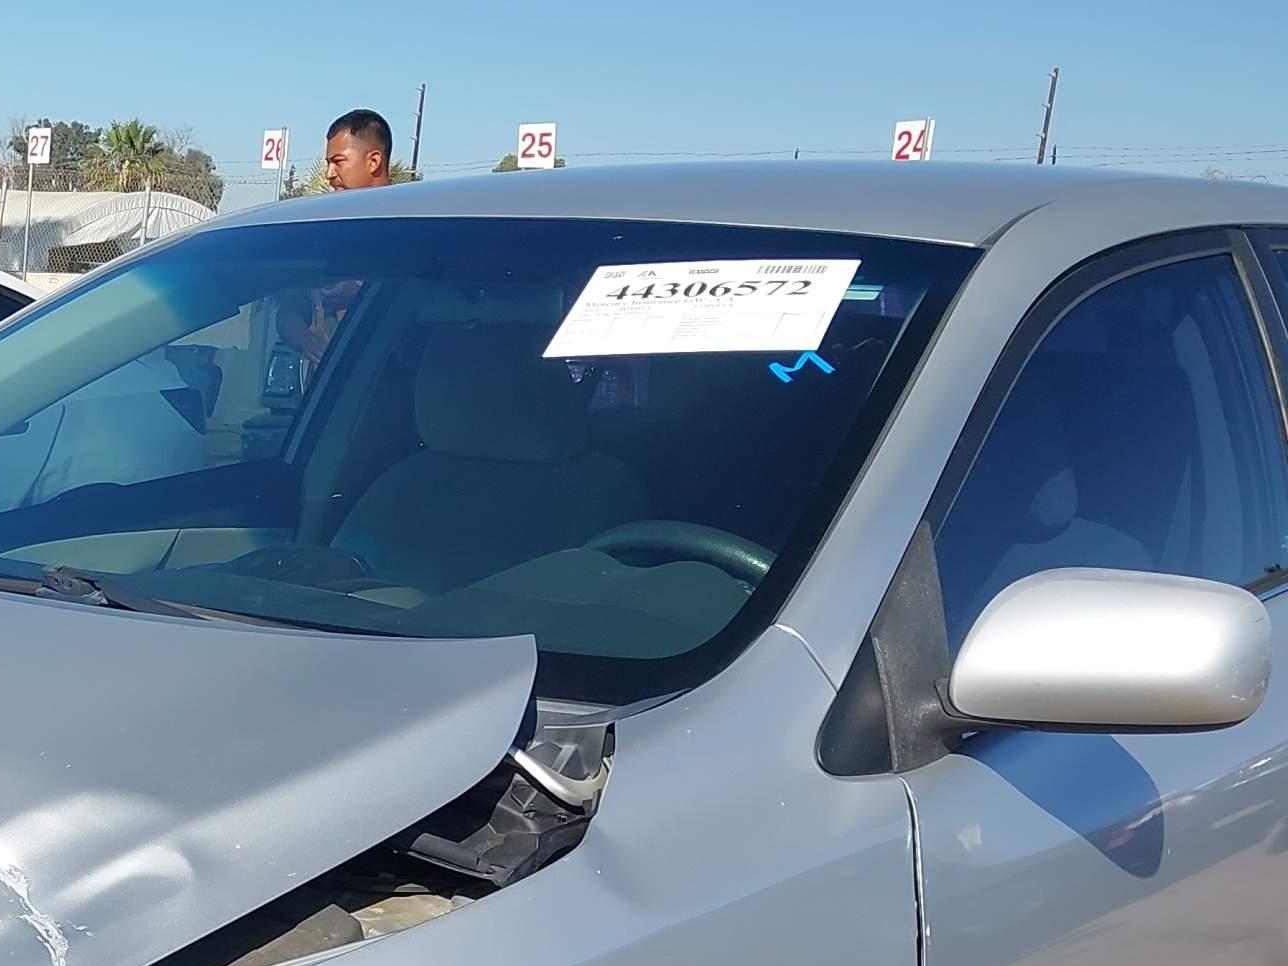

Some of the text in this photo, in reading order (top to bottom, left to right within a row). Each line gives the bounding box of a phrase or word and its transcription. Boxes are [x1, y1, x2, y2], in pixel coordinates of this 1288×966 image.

[29, 135, 49, 157] 27
[521, 132, 553, 159] 25
[895, 129, 928, 160] 24
[606, 279, 813, 301] 44306572
